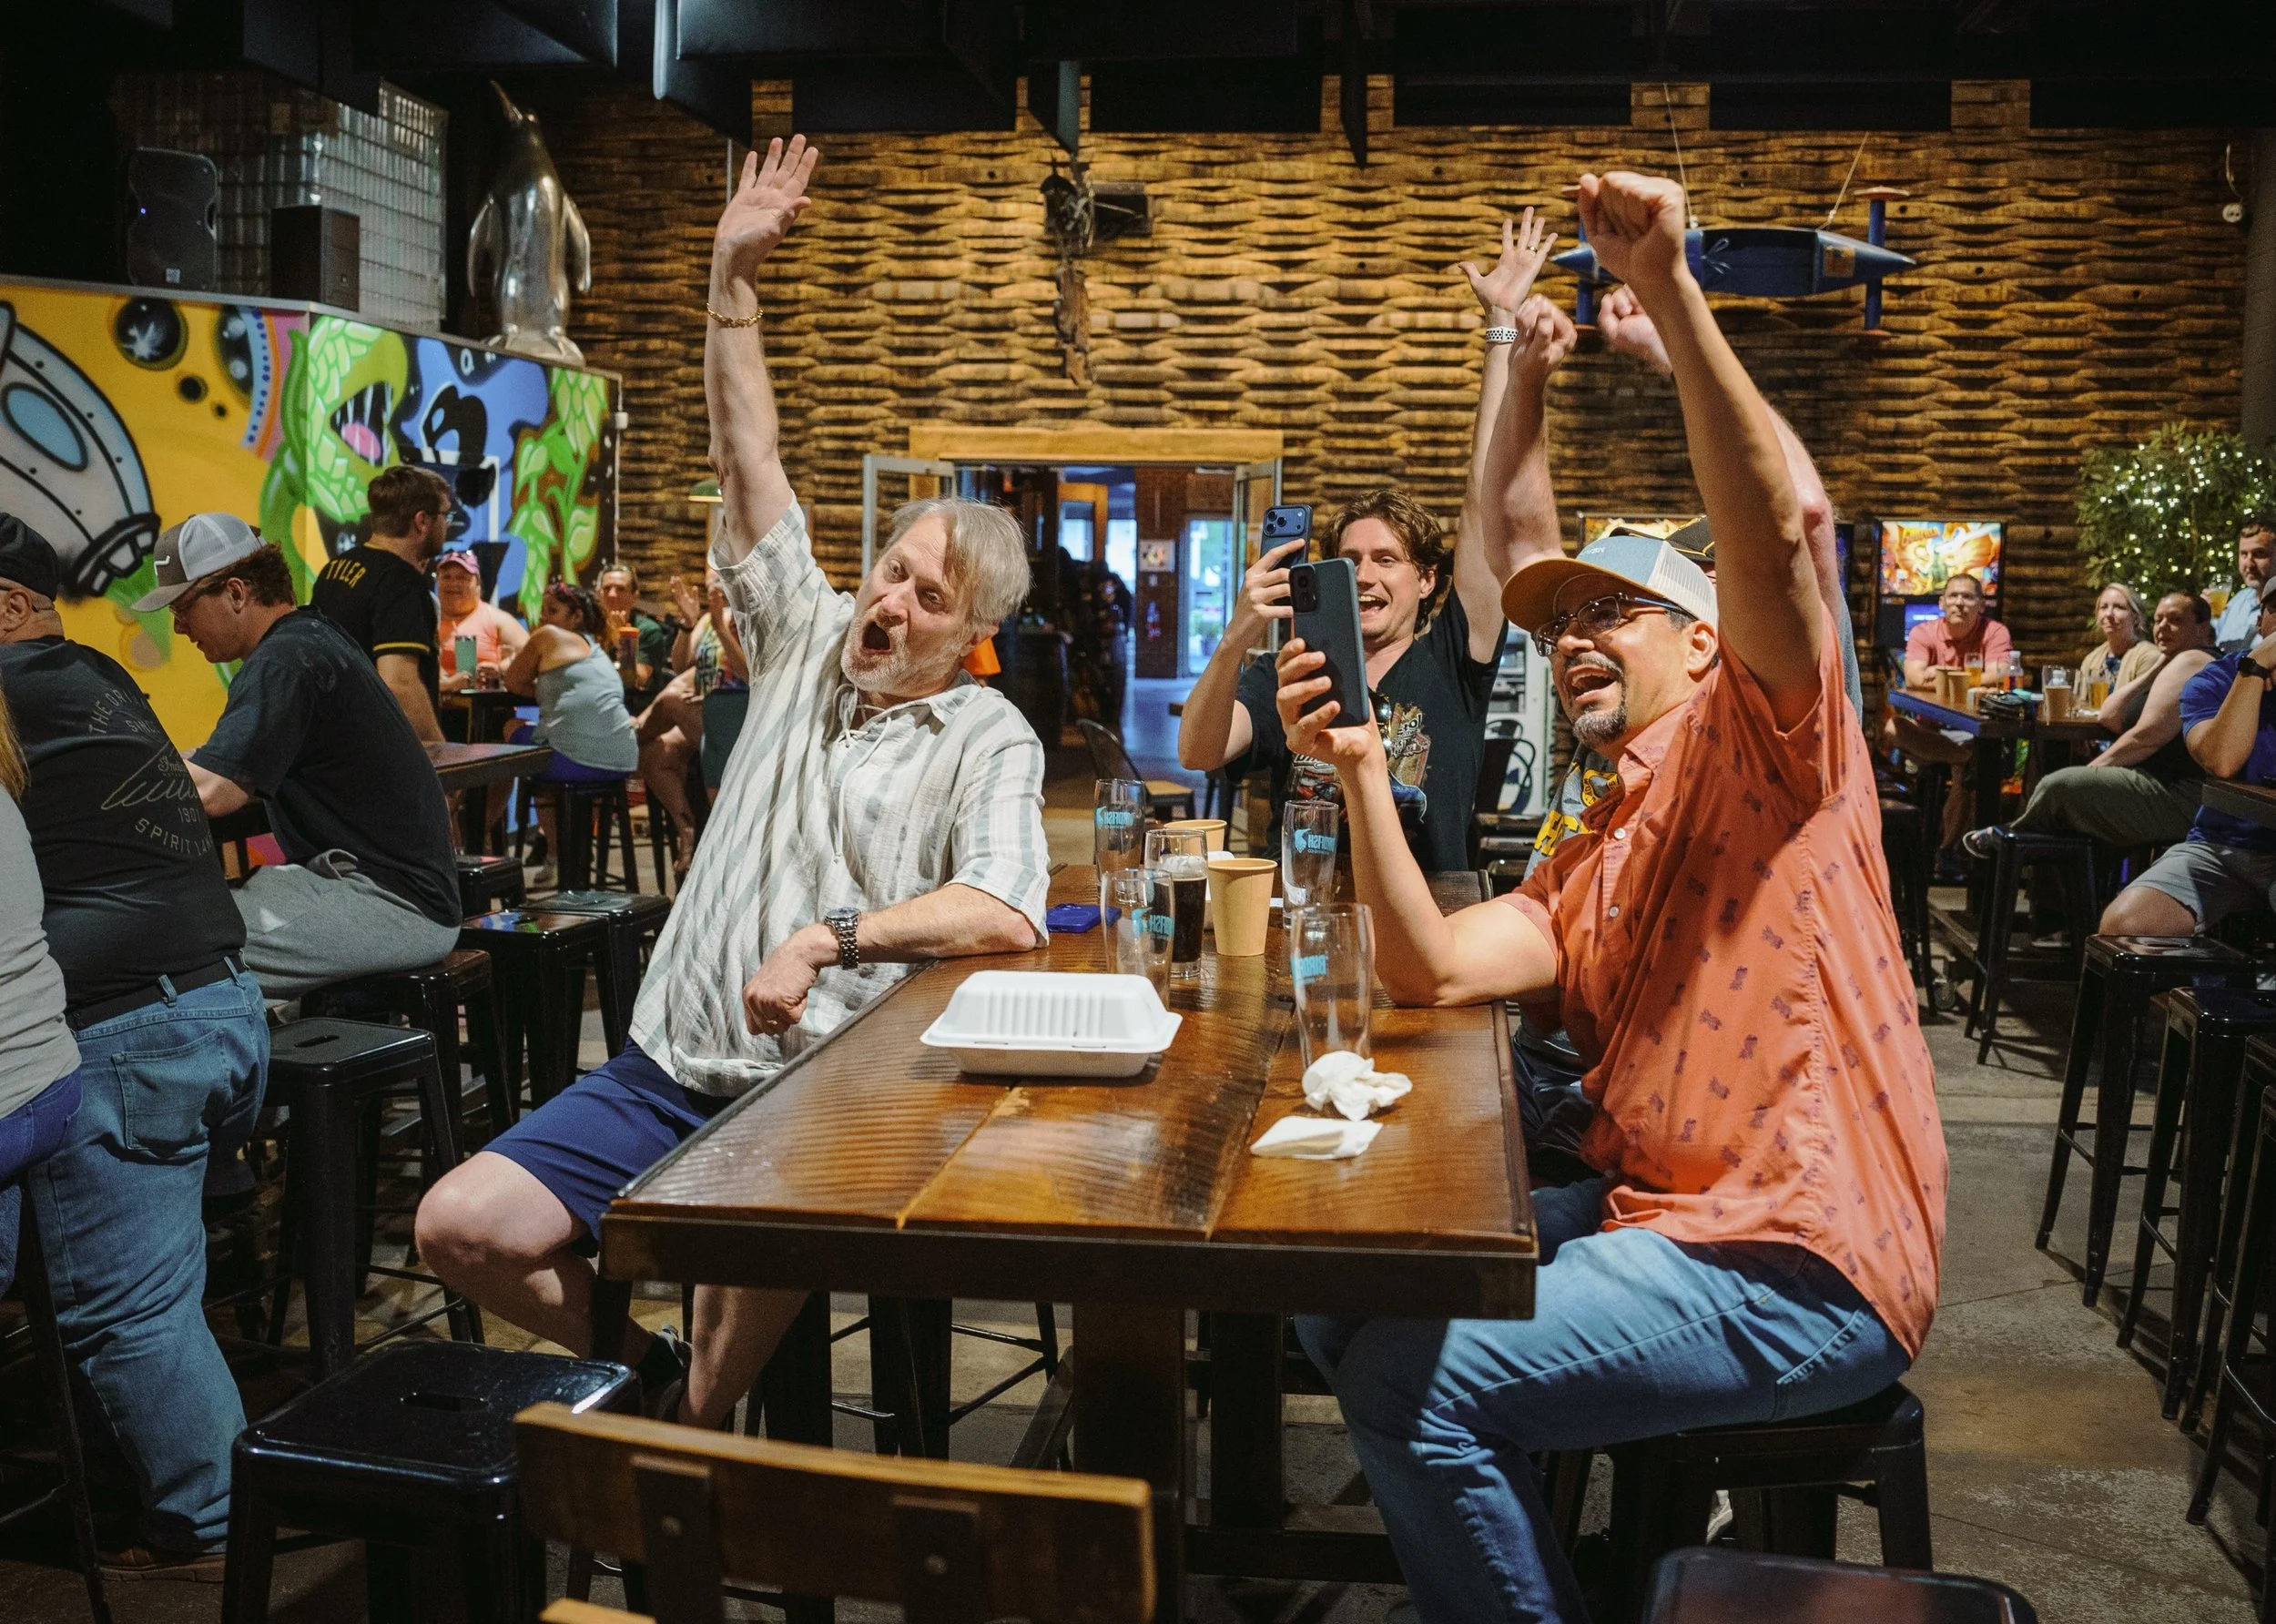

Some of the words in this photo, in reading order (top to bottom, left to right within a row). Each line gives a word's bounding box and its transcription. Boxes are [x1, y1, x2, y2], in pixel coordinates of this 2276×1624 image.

[325, 558, 367, 590] TYLER
[88, 700, 114, 734] THE
[135, 817, 190, 854] SPIRIT
